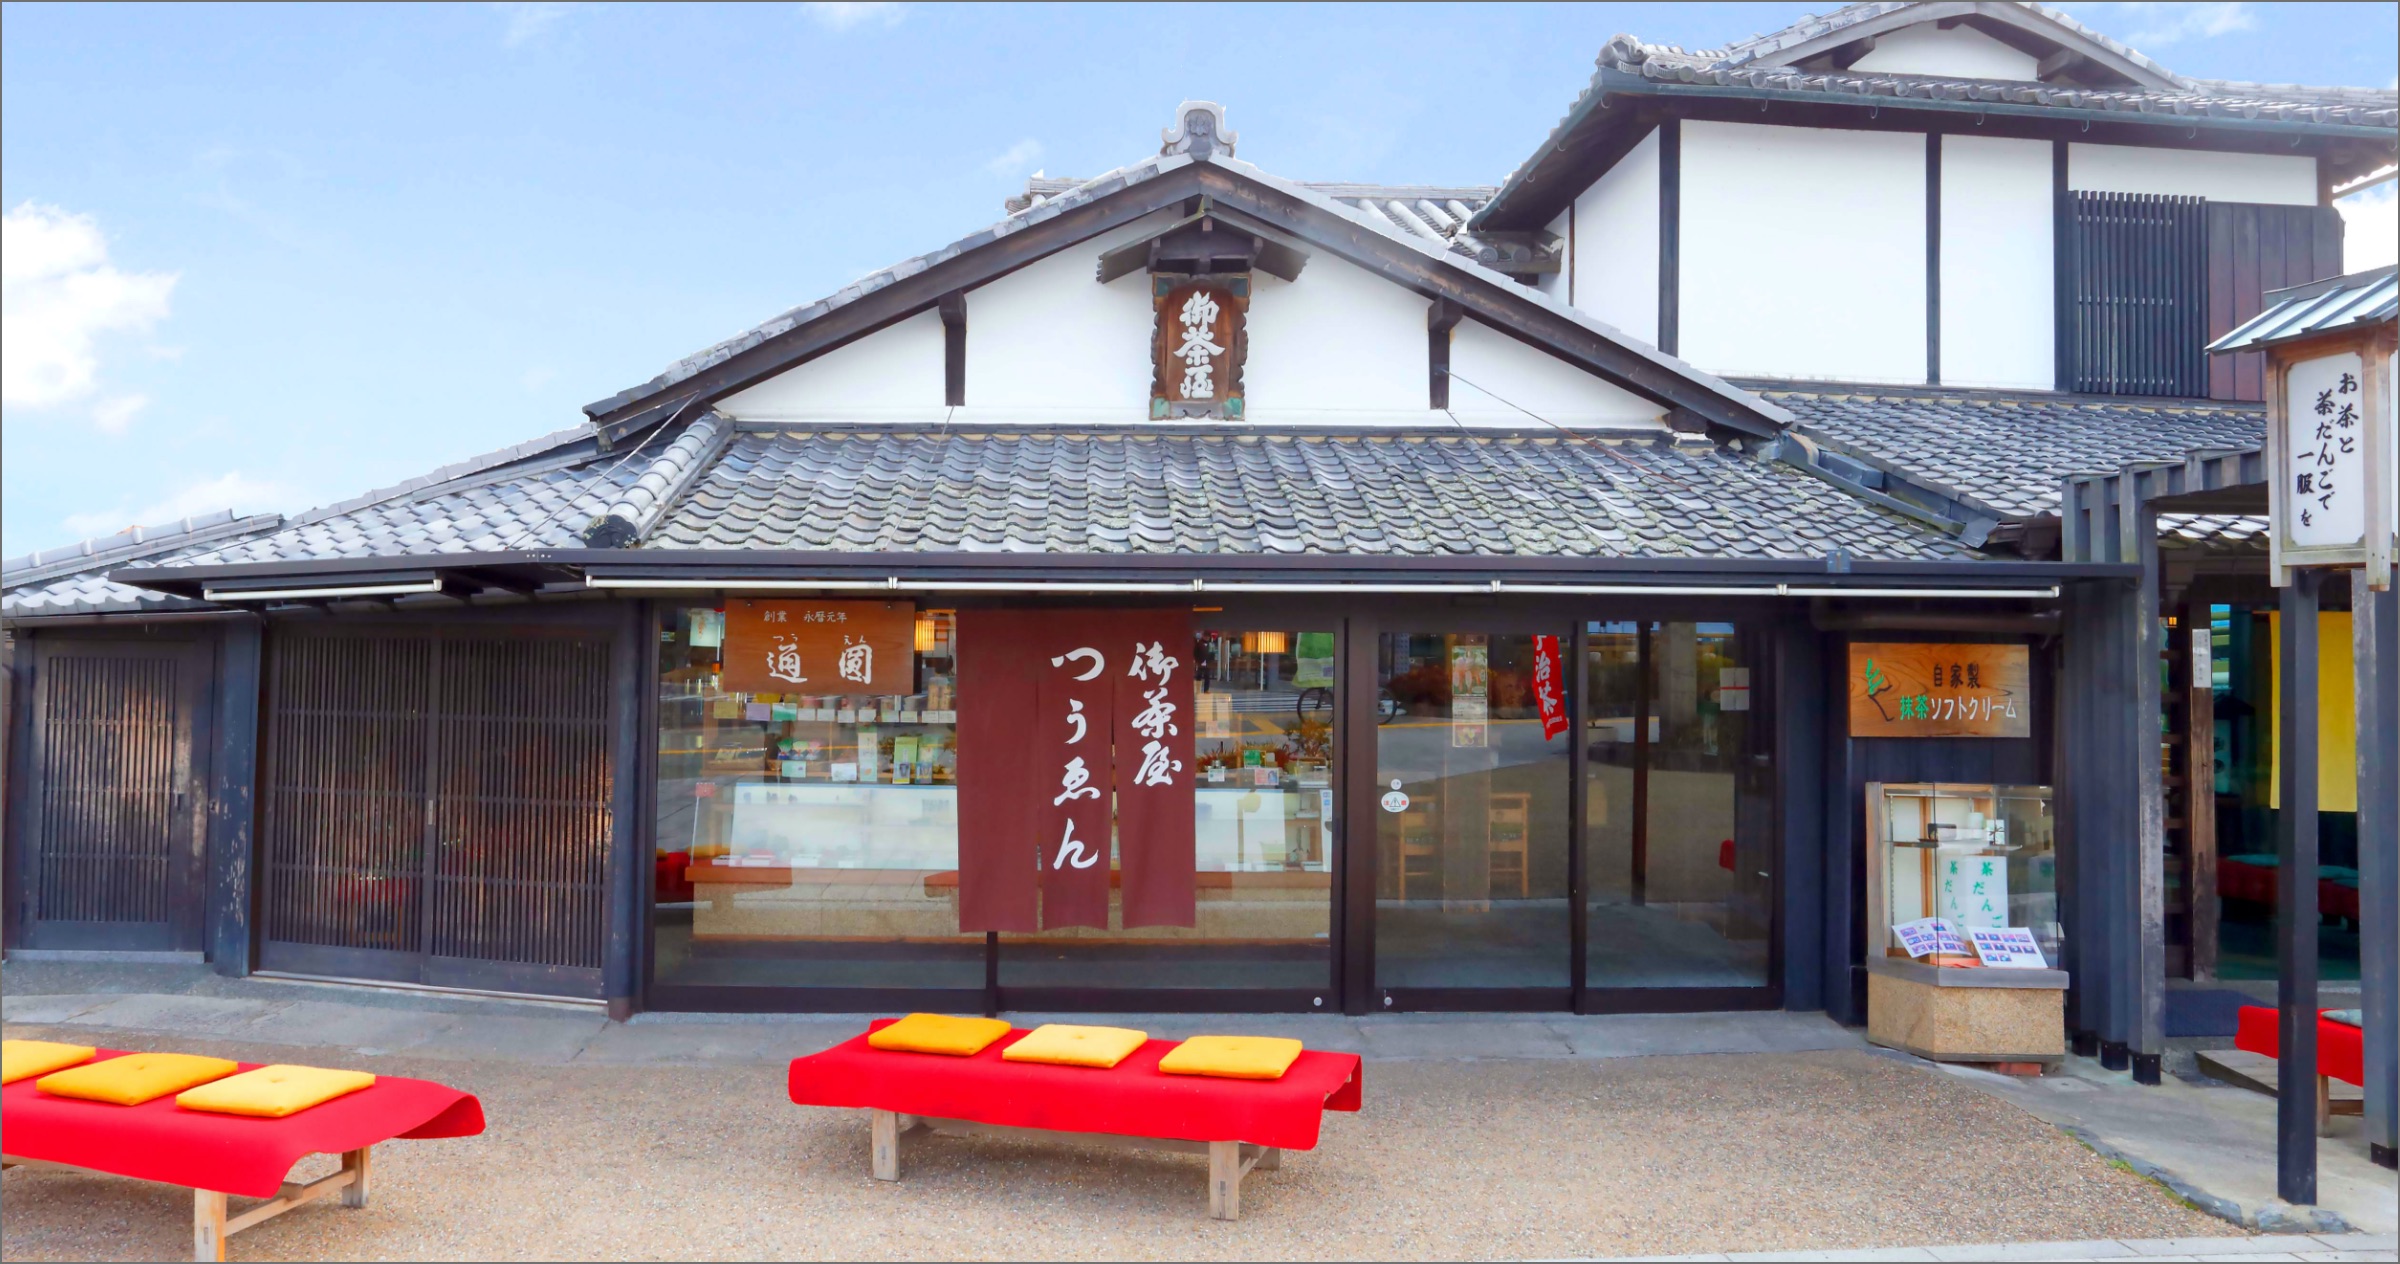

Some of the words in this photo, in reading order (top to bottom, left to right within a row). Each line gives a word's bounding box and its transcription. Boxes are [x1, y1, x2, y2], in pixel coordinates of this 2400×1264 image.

[2314, 388, 2336, 511] 茶だんごで
[2336, 372, 2359, 454] お茶と
[2296, 451, 2316, 528] 一服を
[764, 610, 787, 623] 創業
[803, 610, 848, 623] 永暦元年
[1128, 641, 1183, 787] 御茶屋
[1899, 694, 2018, 723] 抹茶ソフトクリーム
[1933, 662, 1981, 689] 自家製
[1051, 646, 1105, 870] つうゑん
[1973, 861, 2003, 929] 茶だんご
